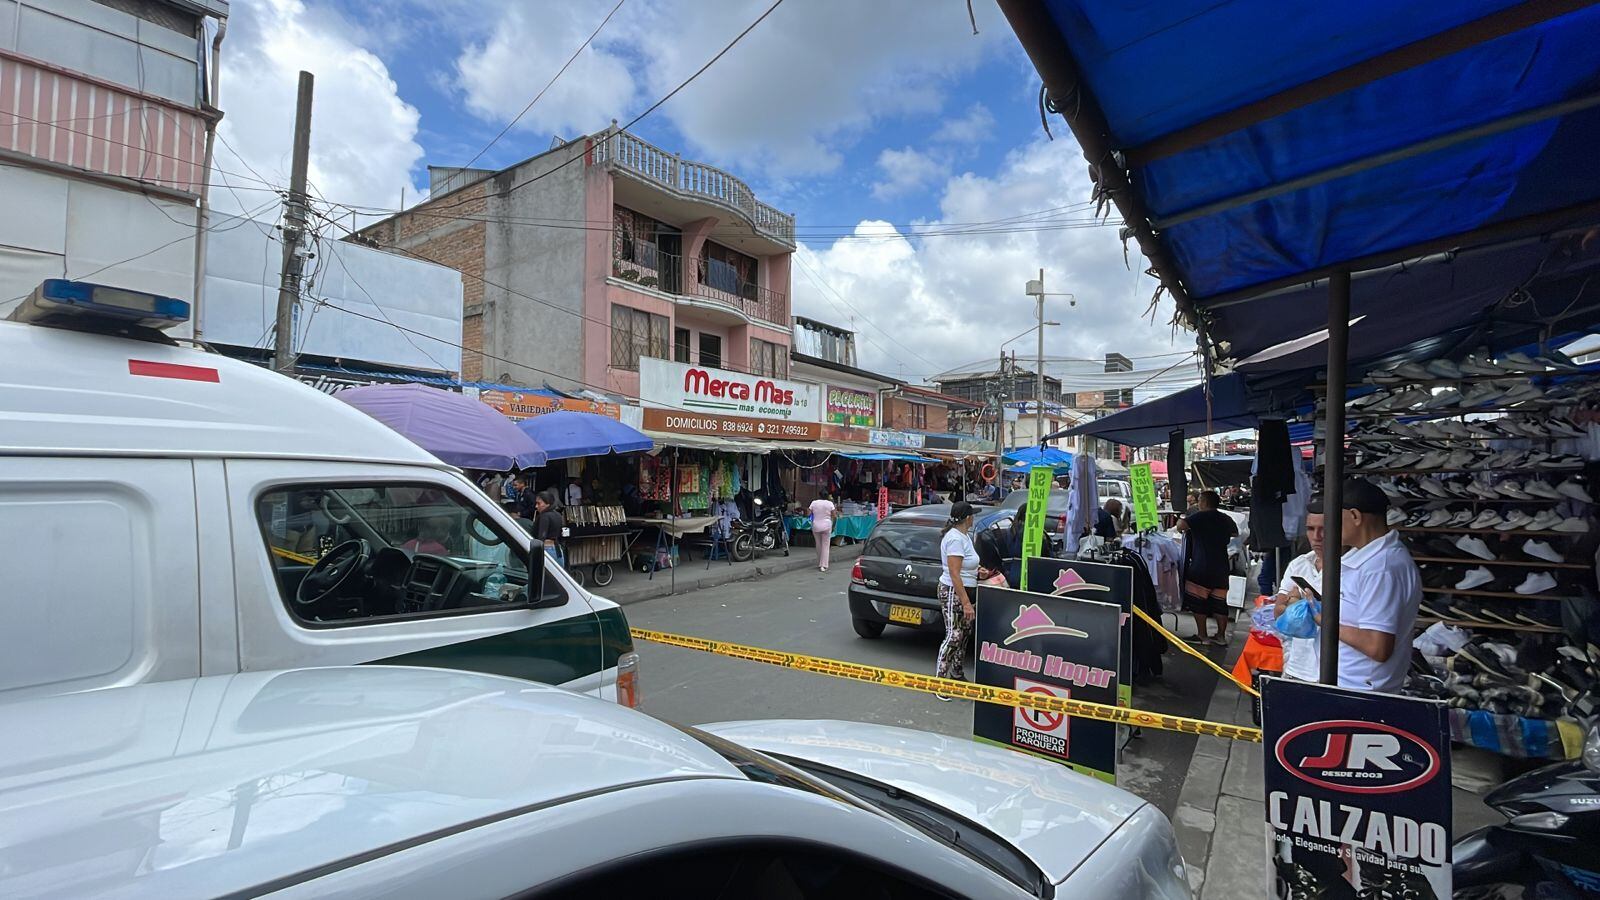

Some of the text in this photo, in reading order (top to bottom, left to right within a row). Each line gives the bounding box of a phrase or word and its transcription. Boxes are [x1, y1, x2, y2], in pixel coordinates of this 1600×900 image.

[684, 368, 750, 401] Merca
[755, 380, 794, 406] Mas
[738, 404, 755, 412] mas
[666, 416, 718, 430] DOMICILIOS
[722, 420, 736, 431] 838
[766, 424, 780, 434] 321
[979, 642, 1116, 688] Mundo Hogar
[1016, 728, 1065, 747] PROHIBIDO
[1016, 735, 1065, 754] PARQUEAR
[1299, 733, 1402, 771] JR
[1321, 770, 1354, 778] DESDE
[1269, 790, 1447, 866] CALZADO
[1295, 836, 1336, 854] Elegancia
[1345, 848, 1385, 866] Savidad
[1387, 860, 1408, 871] para
